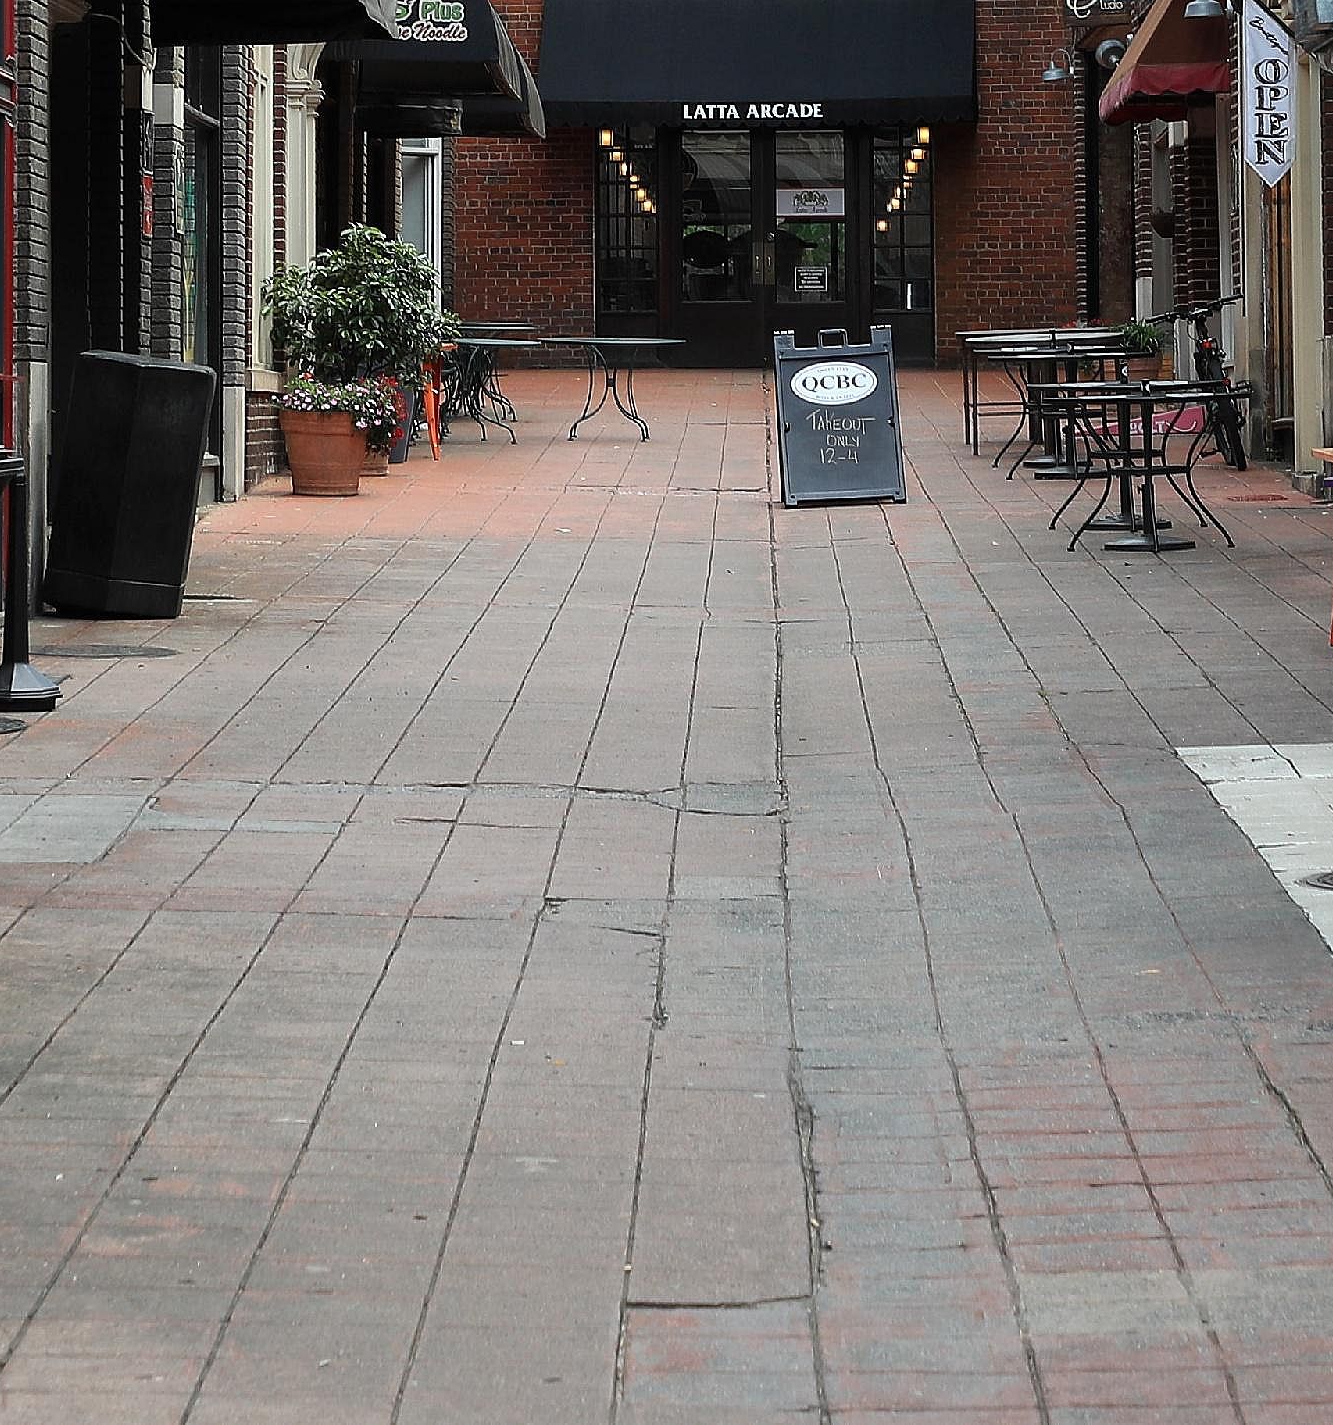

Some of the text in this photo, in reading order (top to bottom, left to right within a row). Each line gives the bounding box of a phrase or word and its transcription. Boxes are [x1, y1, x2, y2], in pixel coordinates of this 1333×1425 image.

[420, 0, 463, 21] Plus
[414, 22, 466, 40] Noodle
[683, 103, 824, 119] LATTA ARCADE
[1254, 58, 1289, 165] OPEN
[801, 372, 866, 392] QCBC
[826, 434, 860, 448] ONLY
